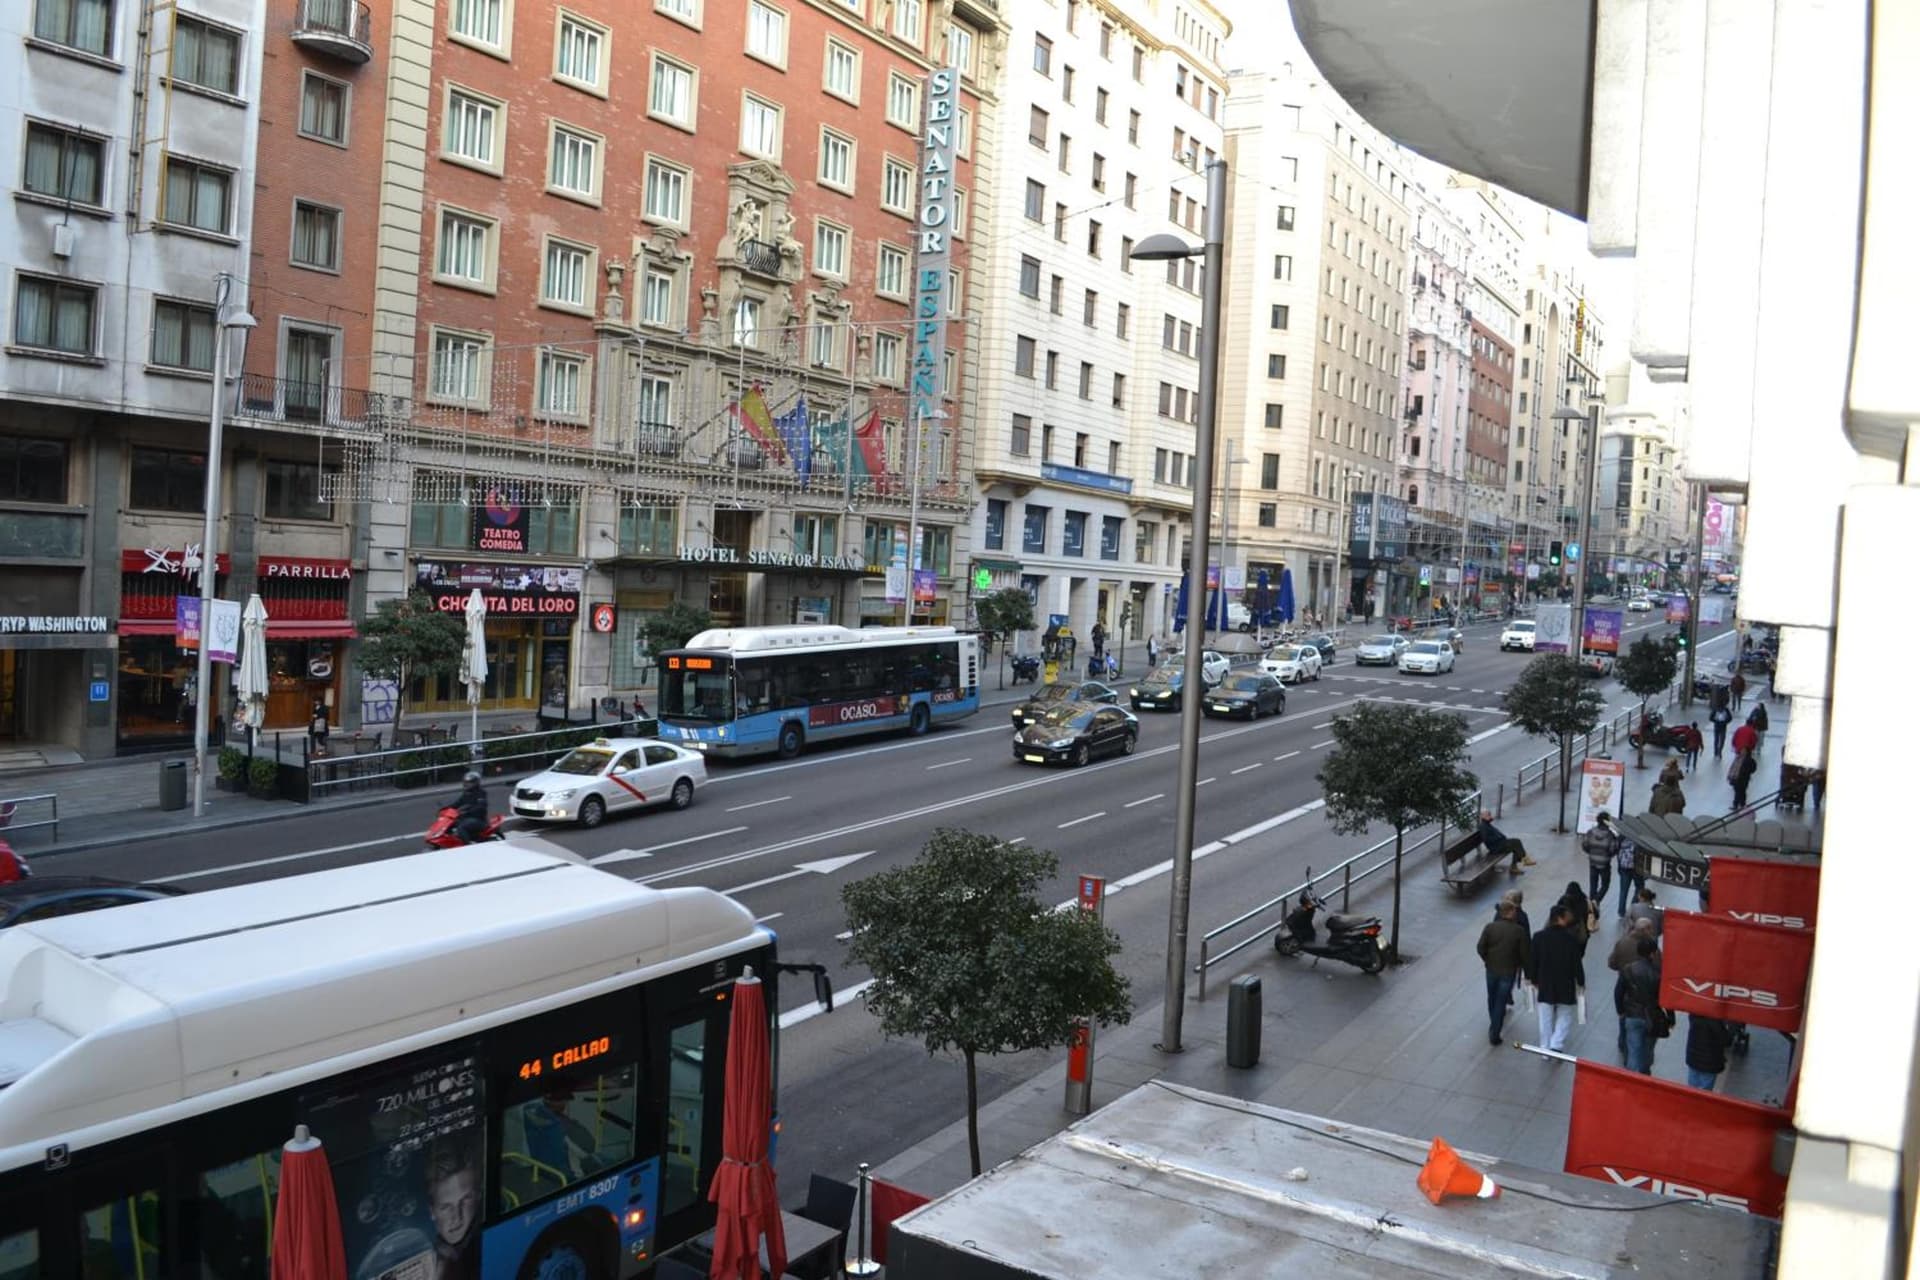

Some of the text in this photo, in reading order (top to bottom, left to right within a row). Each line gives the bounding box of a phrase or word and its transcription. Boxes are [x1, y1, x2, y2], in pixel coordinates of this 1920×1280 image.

[920, 72, 951, 254] SENATOR
[912, 270, 941, 420] ESPAÑA
[483, 527, 520, 540] TEATRO
[480, 538, 523, 550] COMEDIA
[679, 545, 739, 563] HOTEL
[748, 551, 813, 567] SENATOR
[268, 564, 350, 579] PARRILLA
[438, 595, 575, 613] CHOITA DEL LORO
[28, 616, 107, 631] WASHINGTON
[934, 692, 954, 703] OCASO
[840, 703, 877, 721] OCASO
[1727, 910, 1805, 929] VIPS
[1683, 978, 1778, 1007] VIPS
[520, 1036, 610, 1080] 44 CALLAO
[376, 1069, 474, 1114] 720 MILLONES
[556, 1175, 619, 1214] EMT 8307
